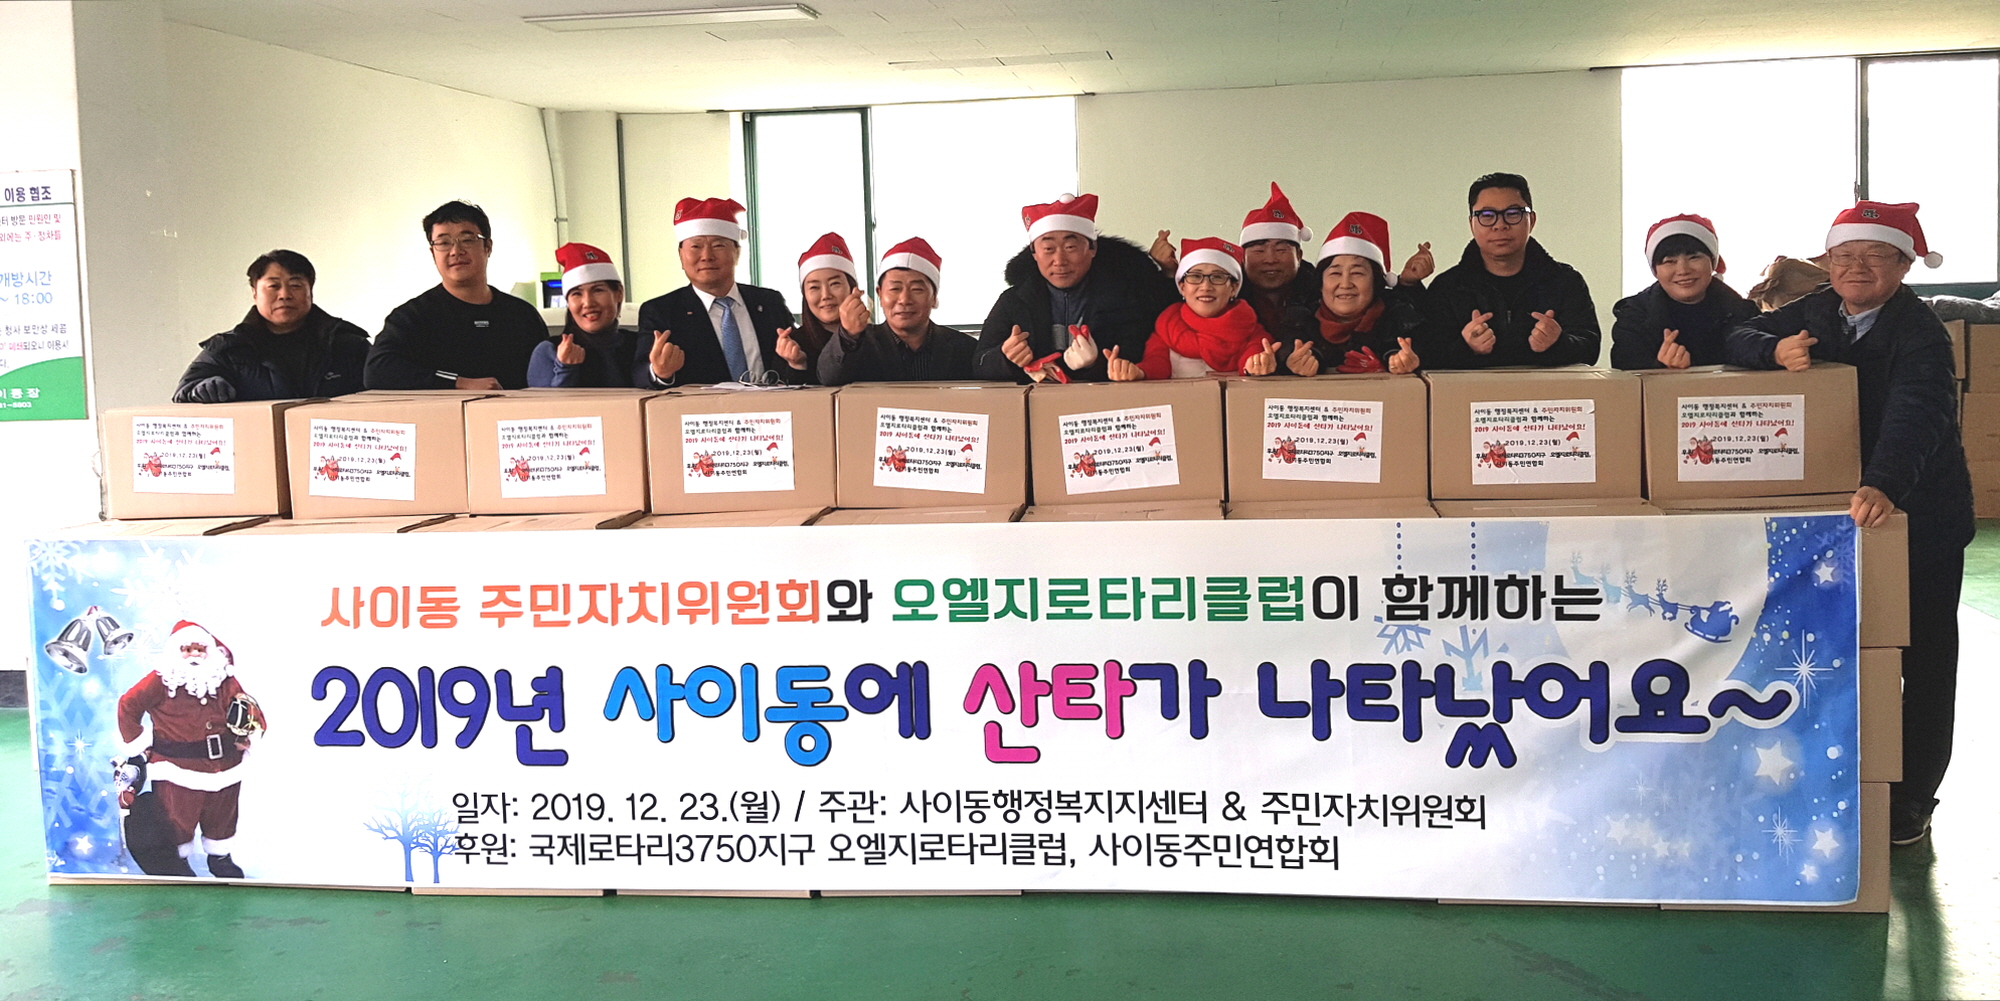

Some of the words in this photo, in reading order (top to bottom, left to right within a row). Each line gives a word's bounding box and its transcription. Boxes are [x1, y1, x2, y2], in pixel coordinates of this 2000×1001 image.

[4, 187, 26, 202] 이용
[29, 186, 52, 201] 협조
[0, 271, 52, 288] 개방시간
[15, 292, 53, 305] 18:00
[321, 585, 460, 629] 사이동
[481, 580, 872, 627] 주민자치위원회와
[893, 576, 1358, 622] 오엘지로타리클럽이
[1381, 573, 1603, 622] 함께하는
[312, 666, 568, 766] 2019년
[604, 661, 931, 766] 사이동에
[963, 659, 1222, 763] 산타가
[1257, 659, 1793, 769] 나타났어요~
[453, 793, 518, 823] 일자:
[532, 794, 613, 822] 2019.
[626, 793, 666, 822] 12.
[795, 791, 805, 822] /
[819, 791, 886, 823] 주관:
[900, 790, 1206, 823] 사이동행정복지지센터
[1223, 792, 1246, 821] &
[1262, 793, 1485, 829] 주민자치위원회
[454, 833, 515, 864] 후원:
[530, 834, 815, 865] 국제로타리3750지구
[828, 833, 1075, 867] 오엘지로타리클럽,
[1089, 833, 1338, 870] 사이동주민연합회
